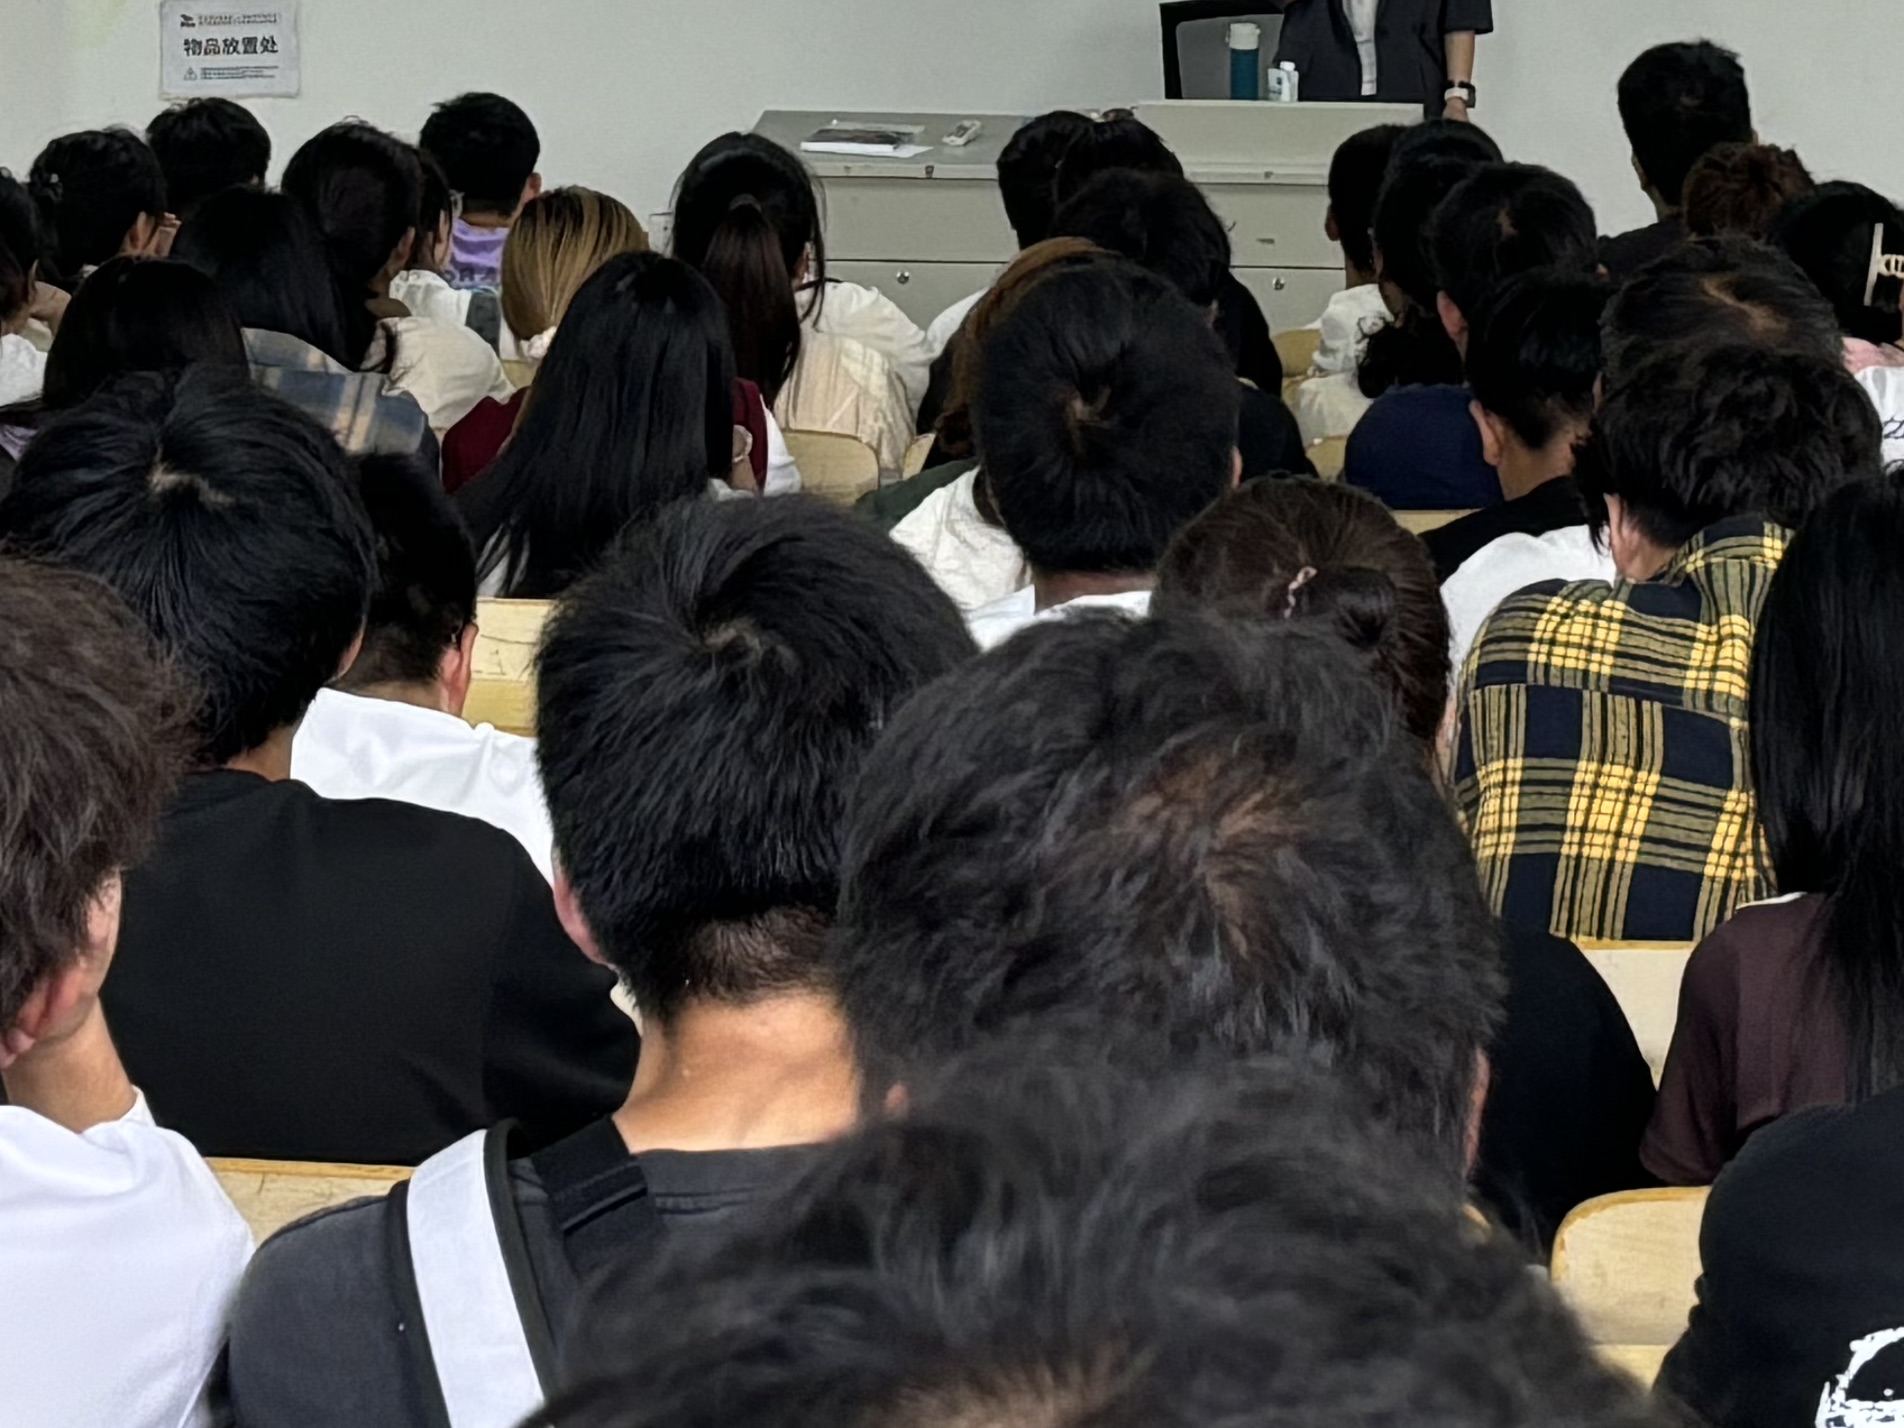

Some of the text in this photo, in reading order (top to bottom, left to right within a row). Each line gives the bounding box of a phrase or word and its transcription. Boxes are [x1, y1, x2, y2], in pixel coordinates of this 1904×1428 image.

[183, 36, 279, 56] 物品放置处
